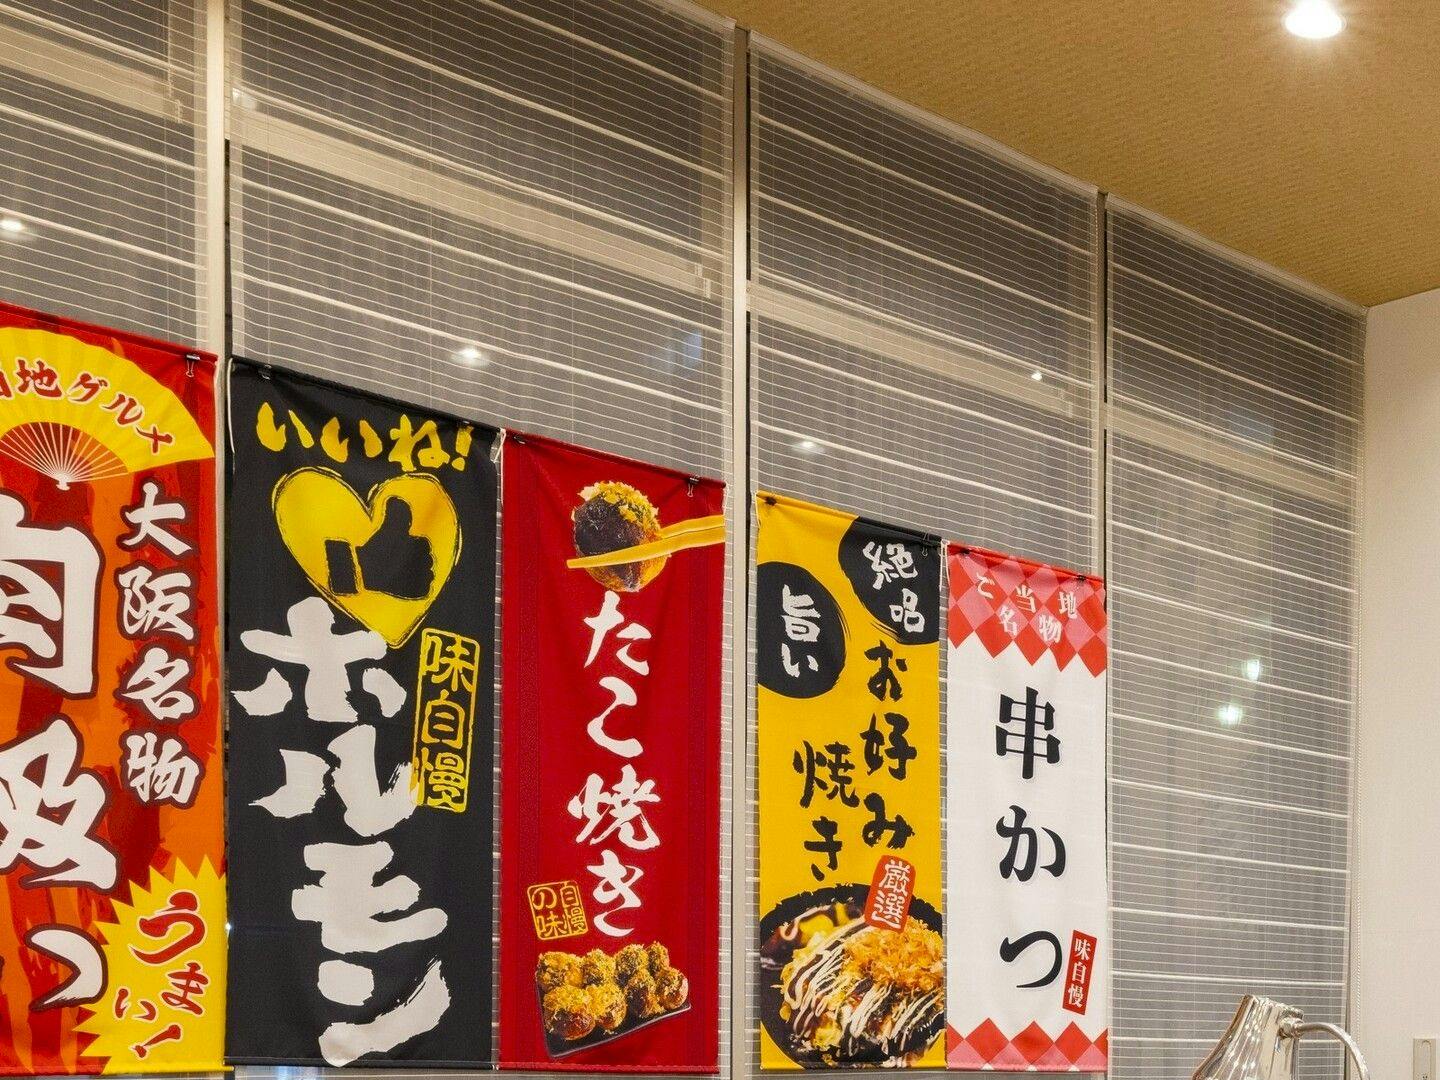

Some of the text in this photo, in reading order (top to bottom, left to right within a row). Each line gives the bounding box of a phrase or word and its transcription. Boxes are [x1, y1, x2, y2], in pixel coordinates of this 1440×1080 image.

[0, 359, 173, 453] 地グルメ
[119, 483, 201, 804] 大阪名物
[781, 584, 820, 678] 旨い
[863, 541, 926, 634] 絶品
[416, 633, 477, 811] 味自慢
[567, 590, 661, 937] たこ焼き
[231, 595, 451, 1067] ホルモン
[867, 860, 913, 928] 厳選
[995, 685, 1066, 989] 串かつ
[1067, 935, 1092, 1009] 味自慢
